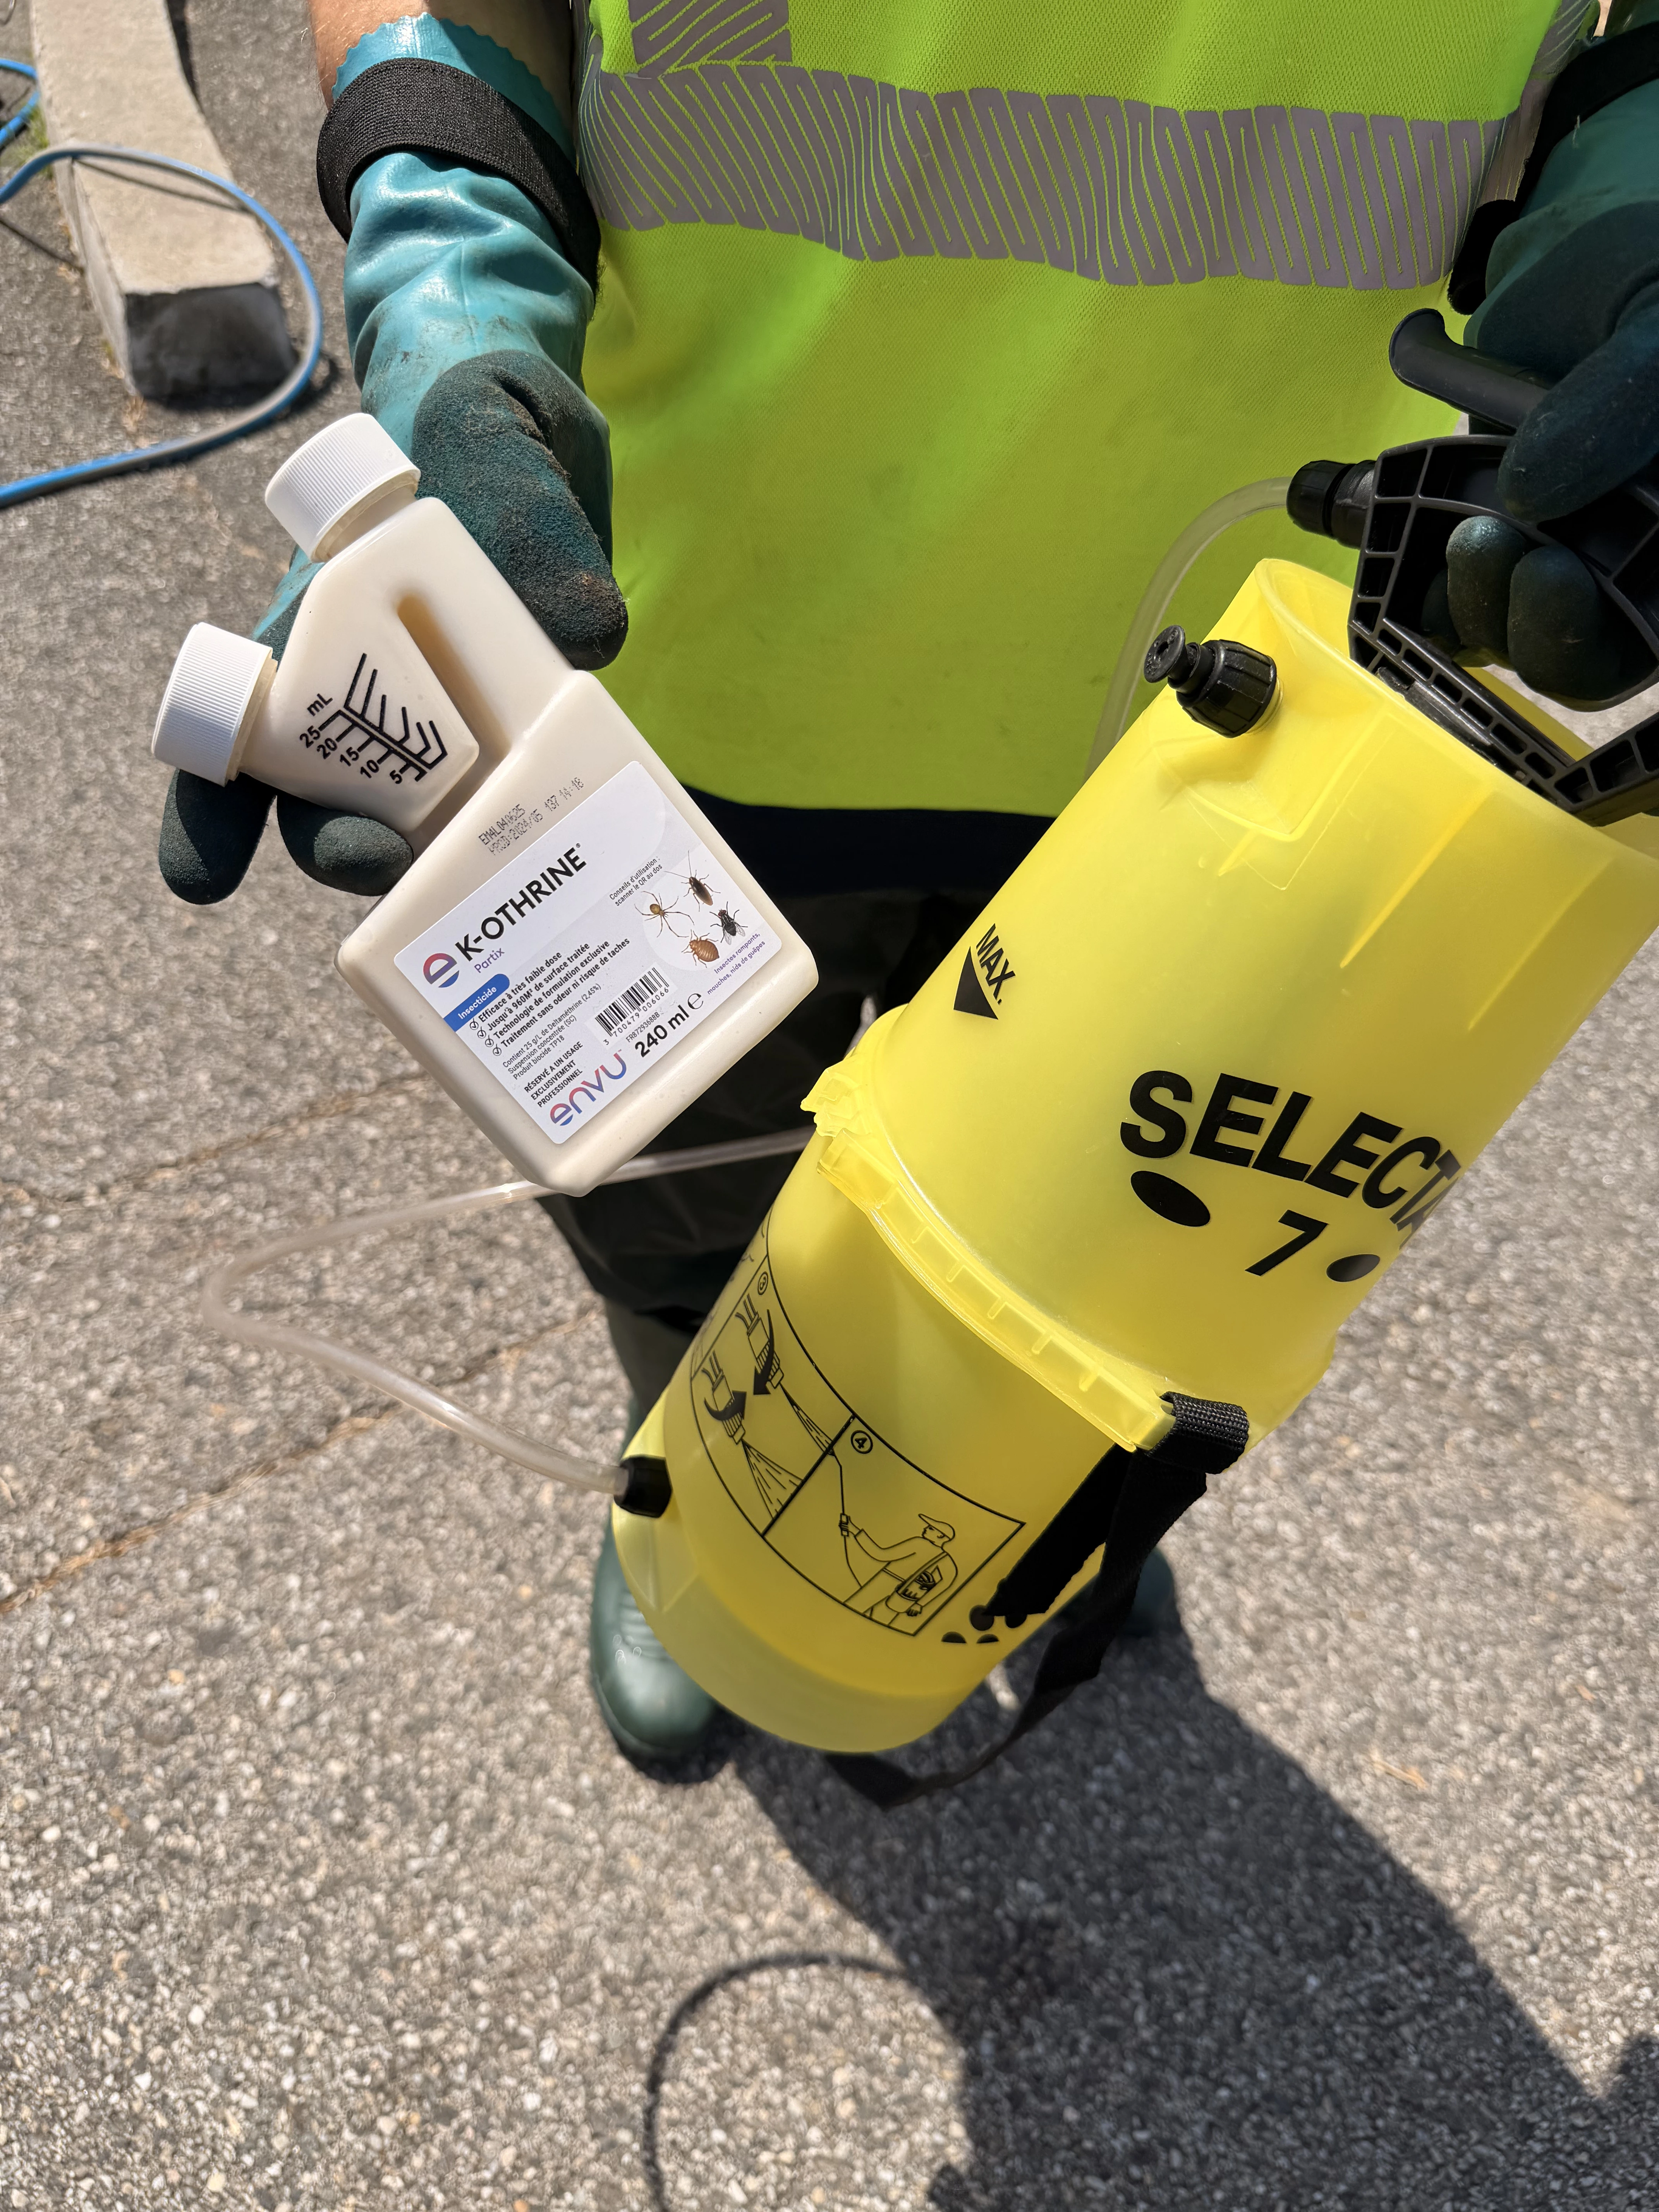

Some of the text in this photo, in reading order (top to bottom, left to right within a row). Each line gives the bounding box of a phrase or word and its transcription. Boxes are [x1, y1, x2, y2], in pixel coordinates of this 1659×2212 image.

[307, 693, 333, 716] mL
[300, 725, 321, 748] 25
[317, 738, 337, 759] 20
[340, 747, 359, 767] 15
[360, 760, 379, 779] 10
[390, 770, 403, 784] 5
[609, 881, 631, 900] Conseils
[630, 859, 657, 883] d'utilisation
[615, 888, 634, 906] scanner
[638, 877, 647, 886] QR
[653, 864, 663, 874] dos
[474, 948, 505, 973] Partix
[707, 974, 732, 995] mouches,
[730, 963, 742, 974] nids
[747, 941, 765, 959] guêpes
[714, 933, 760, 974] Insectes rampants,
[976, 923, 1015, 1005] MAX.
[458, 987, 497, 1019] Insecticide
[478, 998, 507, 1022] Efficace
[511, 982, 526, 995] très
[525, 966, 546, 984] faible
[545, 952, 562, 967] dose
[488, 1007, 514, 1031] Jusqu'à
[534, 982, 544, 991] de
[543, 962, 568, 984] surface
[567, 943, 590, 963] traitée
[493, 941, 610, 1039] Technologie de formulation exclusive
[500, 938, 630, 1047] Traitement sans odeur ni risque de taches
[503, 1048, 526, 1068] Contient
[524, 1041, 532, 1050] 25
[532, 1034, 542, 1045] g/L
[547, 1000, 582, 1030] Deltaméthrine
[581, 983, 601, 1002] (2,45%)
[508, 1015, 577, 1076] Suspension concentrée (SC)
[626, 1012, 660, 1042] FR87293688B
[635, 1025, 668, 1058] 240
[668, 1005, 689, 1030] ml
[513, 1035, 565, 1080] Produit biocide TP18
[524, 1068, 550, 1093] RÉSERVÉ
[553, 1057, 564, 1067] UN
[562, 1041, 583, 1060] USAGE
[531, 1060, 576, 1100] EXCLUSIVEMENT
[537, 1068, 583, 1108] PROFESSIONNEL
[1245, 1210, 1328, 1277] 7
